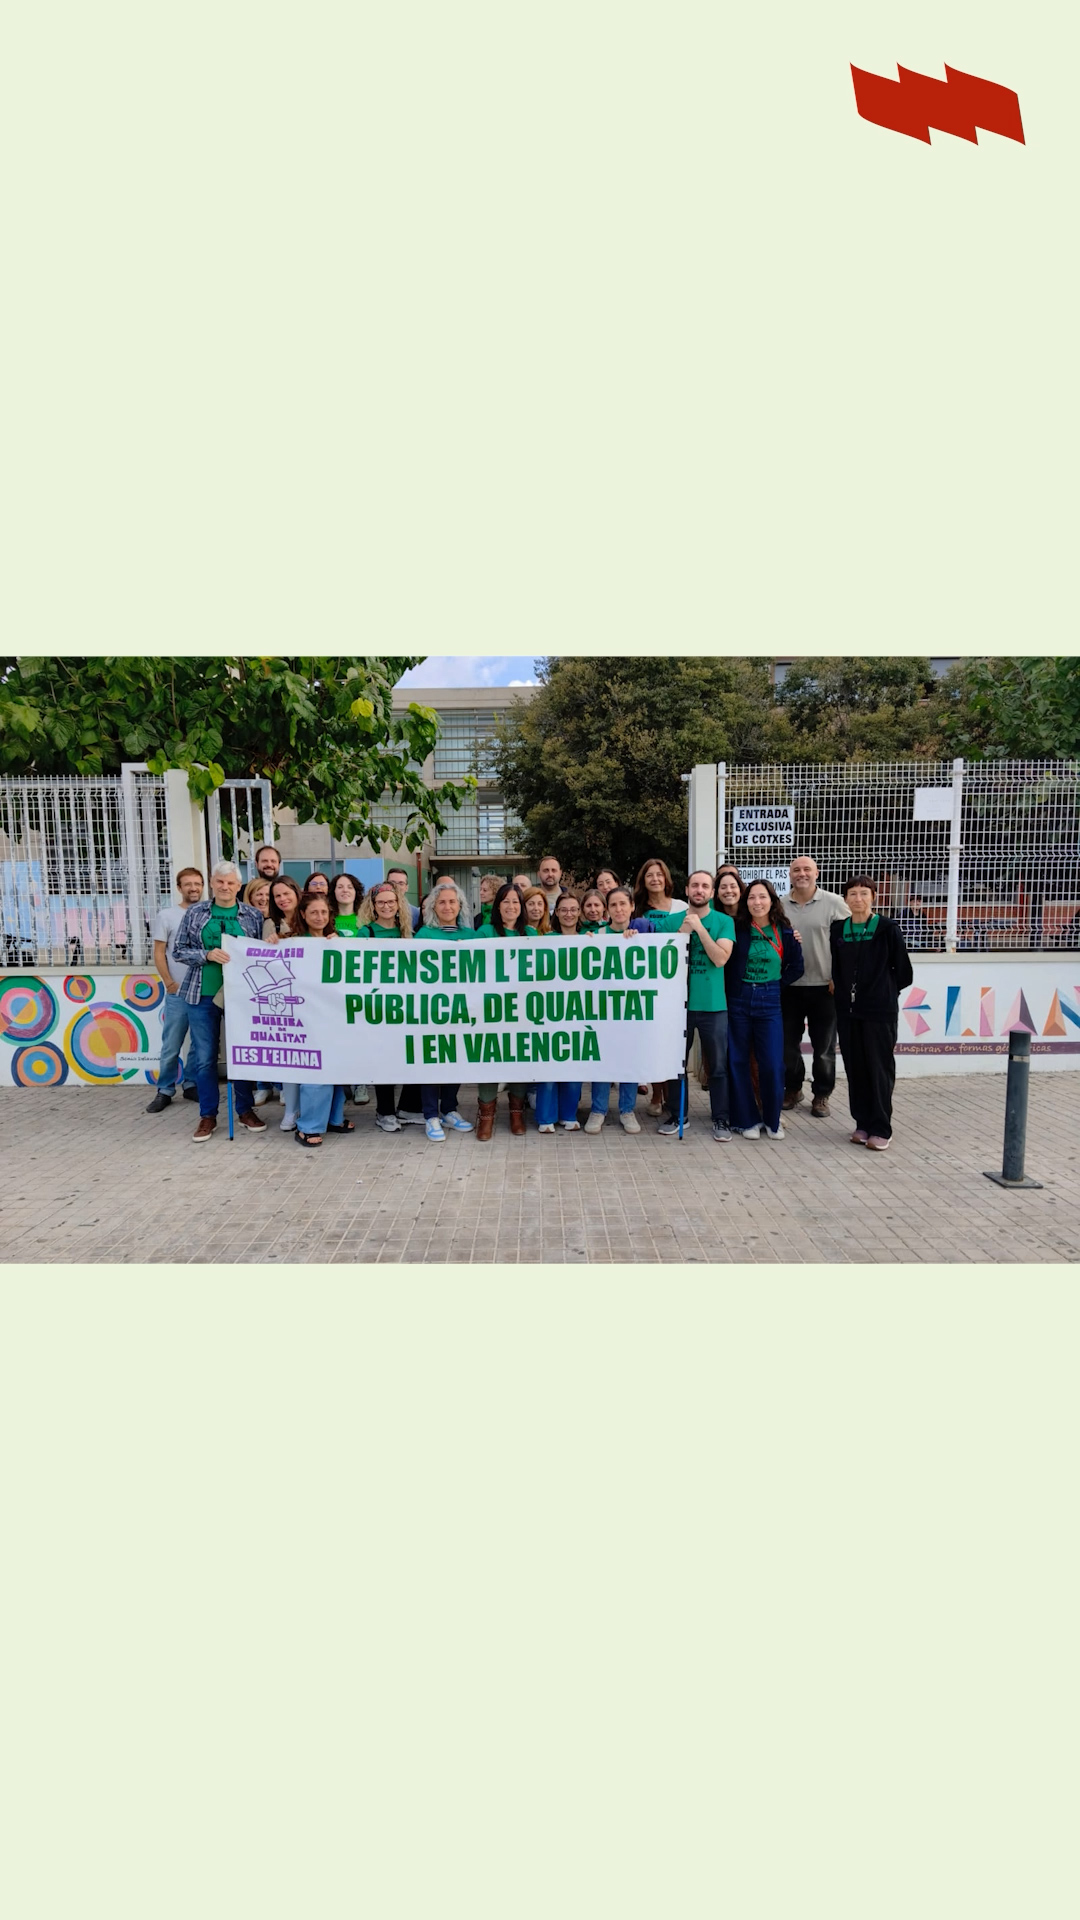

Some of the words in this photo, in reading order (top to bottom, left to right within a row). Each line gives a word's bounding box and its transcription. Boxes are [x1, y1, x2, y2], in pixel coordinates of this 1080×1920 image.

[739, 809, 789, 819] ENTRADA
[735, 821, 792, 832] EXCLUSIVA
[735, 835, 749, 844] DE
[752, 834, 792, 844] COTXES
[765, 869, 773, 879] EL
[775, 869, 788, 879] PAS
[321, 948, 486, 985] DEFENSEM
[345, 987, 477, 1028] PÚBLICA,
[483, 993, 519, 1023] DE
[525, 989, 658, 1023] QUALITAT
[250, 1031, 307, 1044] QUALITAT
[405, 1034, 416, 1065] I
[422, 1033, 459, 1065] EN
[464, 1024, 602, 1064] VALENCIÀ
[899, 1044, 942, 1055] inspiran
[959, 1043, 993, 1054] formas
[235, 1048, 259, 1063] IES
